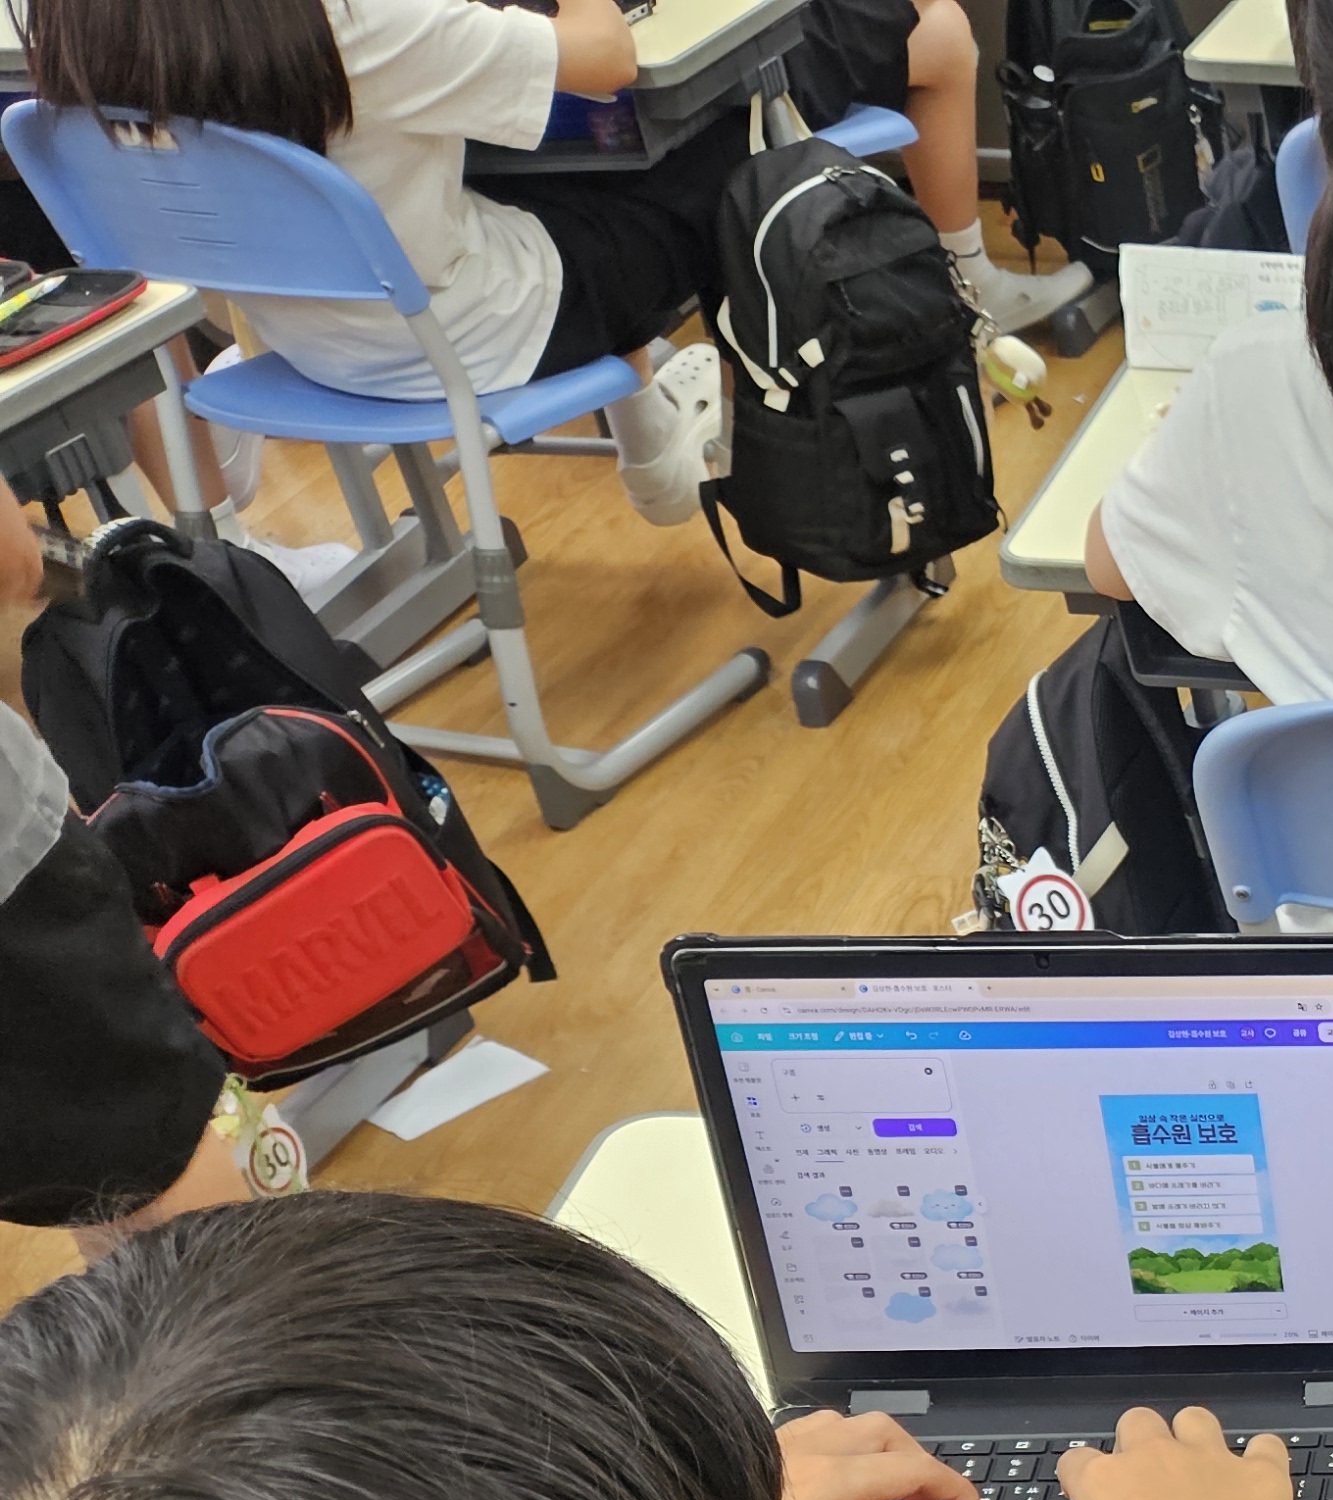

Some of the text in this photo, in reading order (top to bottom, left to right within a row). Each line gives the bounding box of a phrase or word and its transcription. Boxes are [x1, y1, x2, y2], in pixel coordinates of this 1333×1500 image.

[1028, 890, 1071, 930] 30
[211, 875, 447, 1036] MARVEL
[1131, 1123, 1238, 1145] 흡수원 보호
[1139, 1114, 1225, 1123] 일상 속 작은 실천으로
